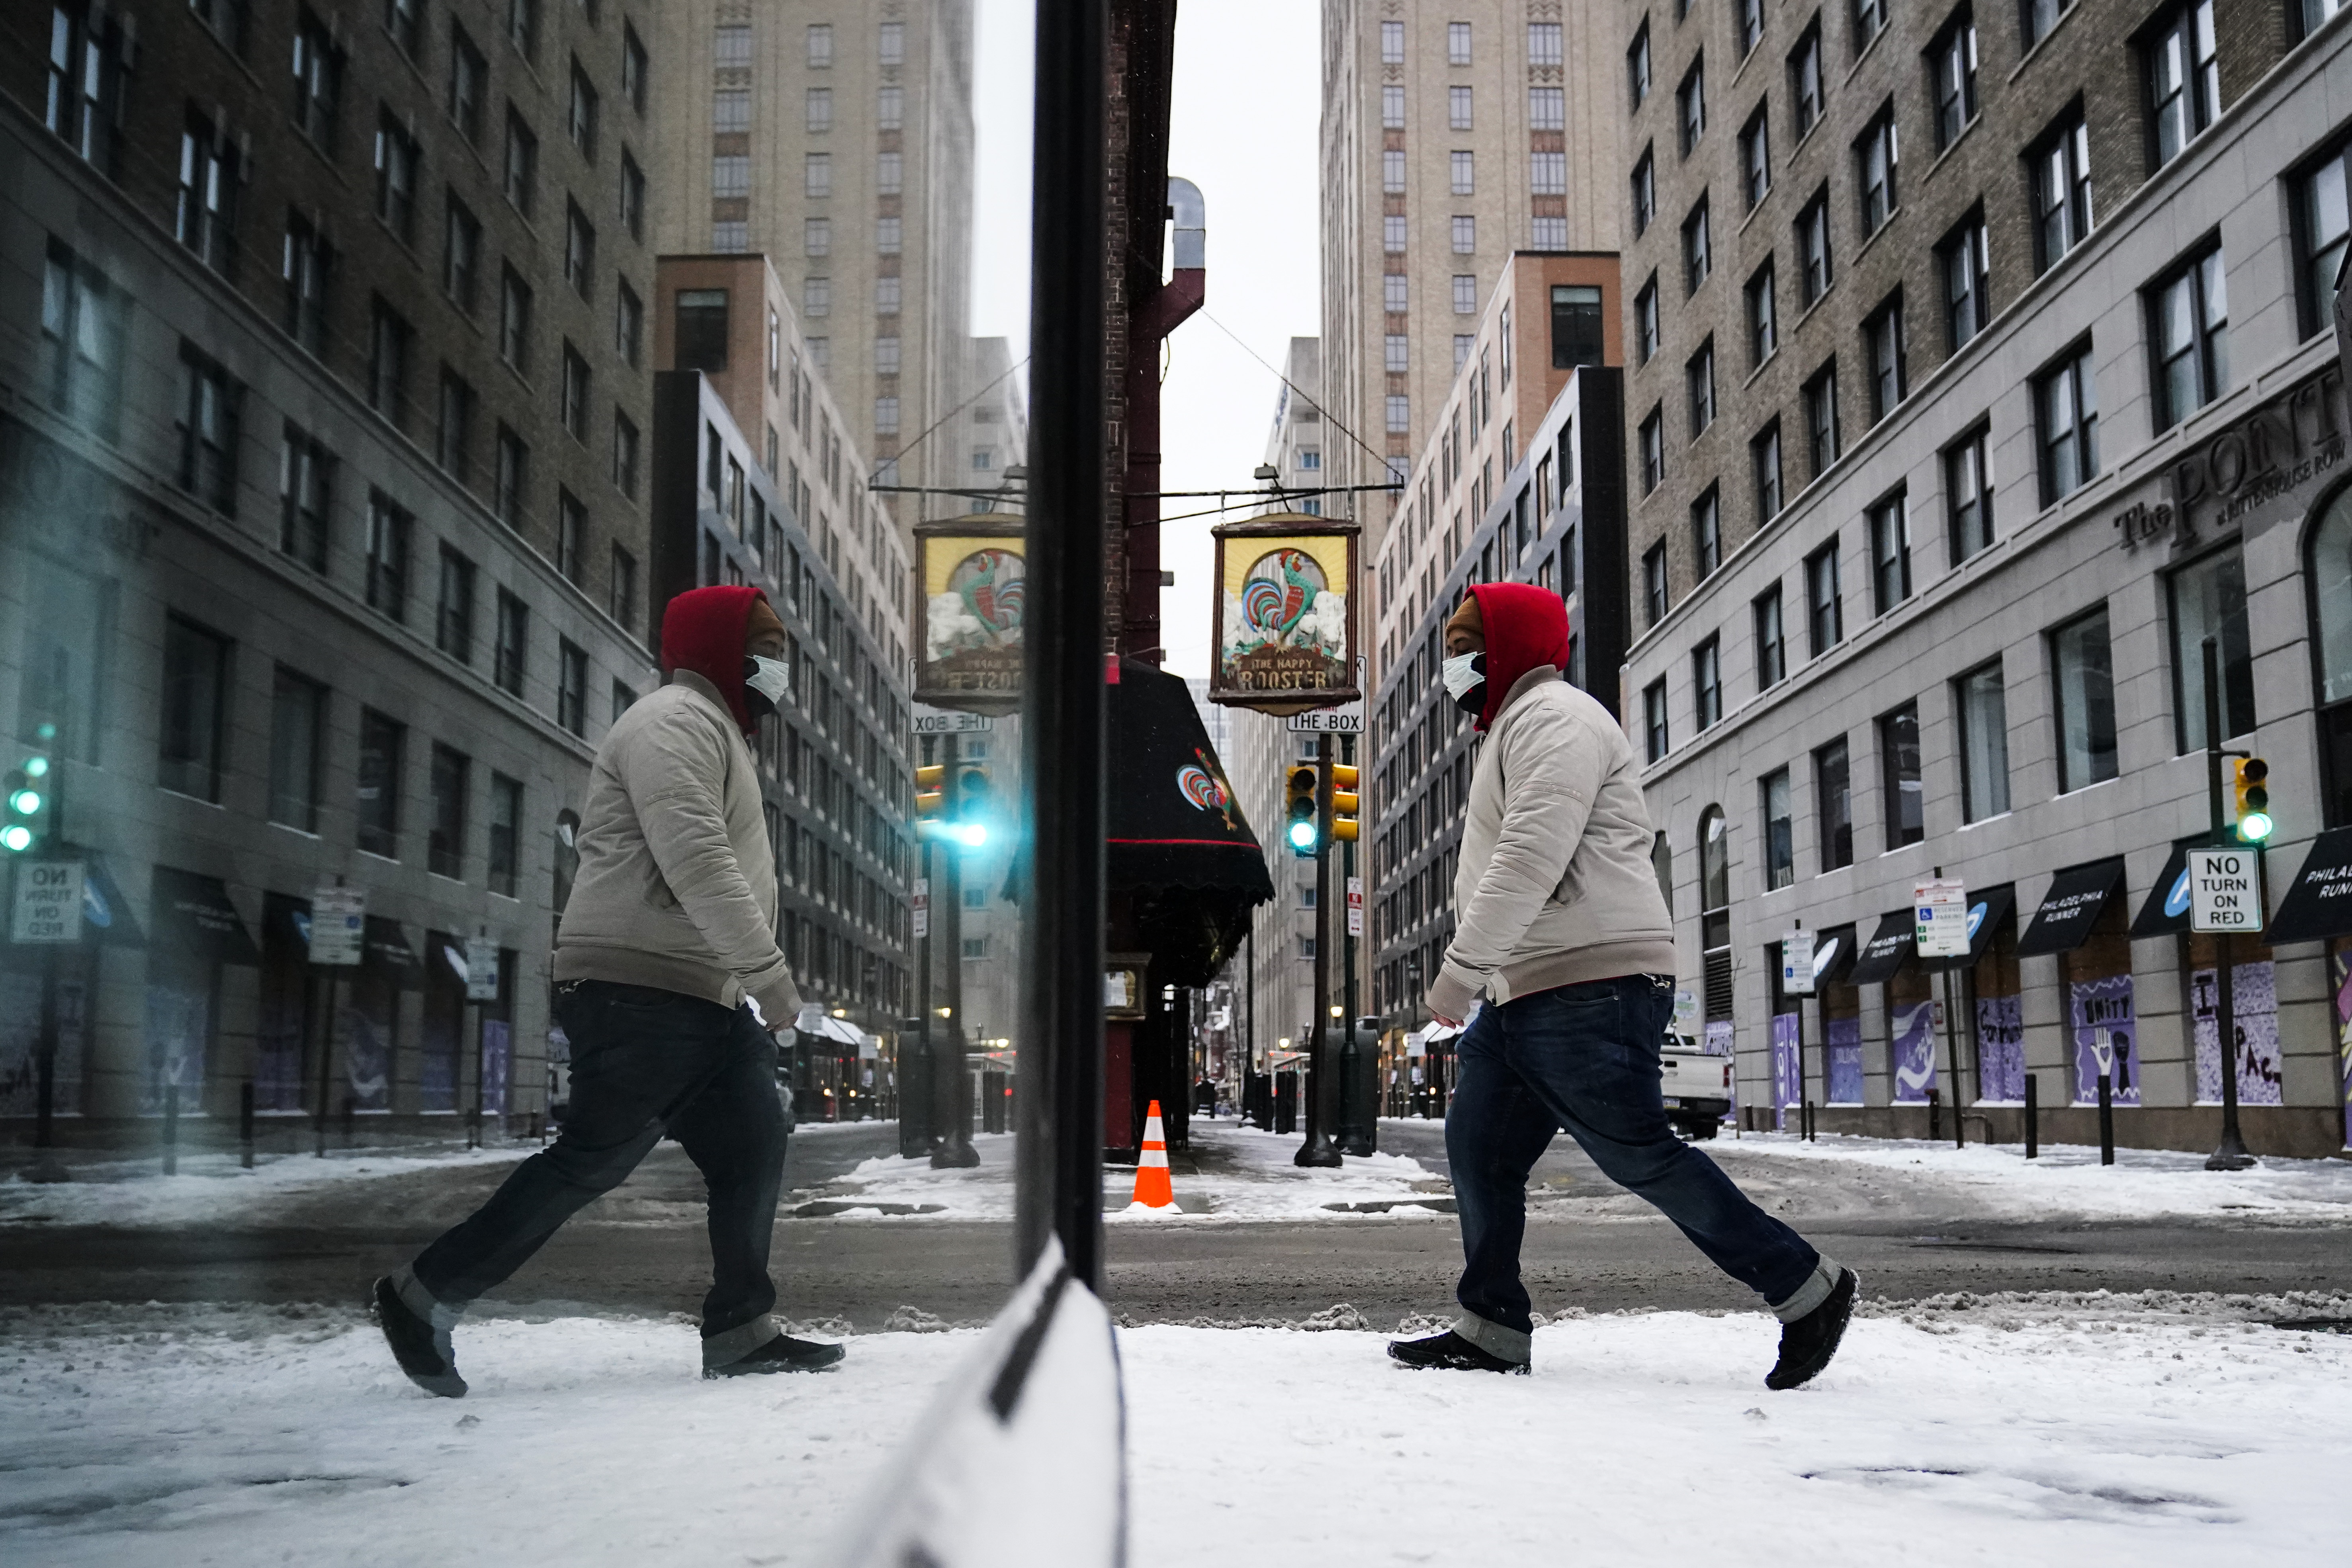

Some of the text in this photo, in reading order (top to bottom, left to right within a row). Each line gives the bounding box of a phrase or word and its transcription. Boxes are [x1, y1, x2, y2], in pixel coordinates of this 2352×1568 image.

[2113, 367, 2344, 550] The POINT
[2315, 438, 2345, 475] ROW
[1253, 659, 1312, 669] THE HAPPY
[1240, 671, 1327, 689] ROOSTER
[1295, 714, 1359, 730] THE BOX
[2206, 857, 2241, 875] NO
[2200, 879, 2248, 892] TURN
[2215, 895, 2238, 908] ON
[2210, 912, 2244, 924] RED
